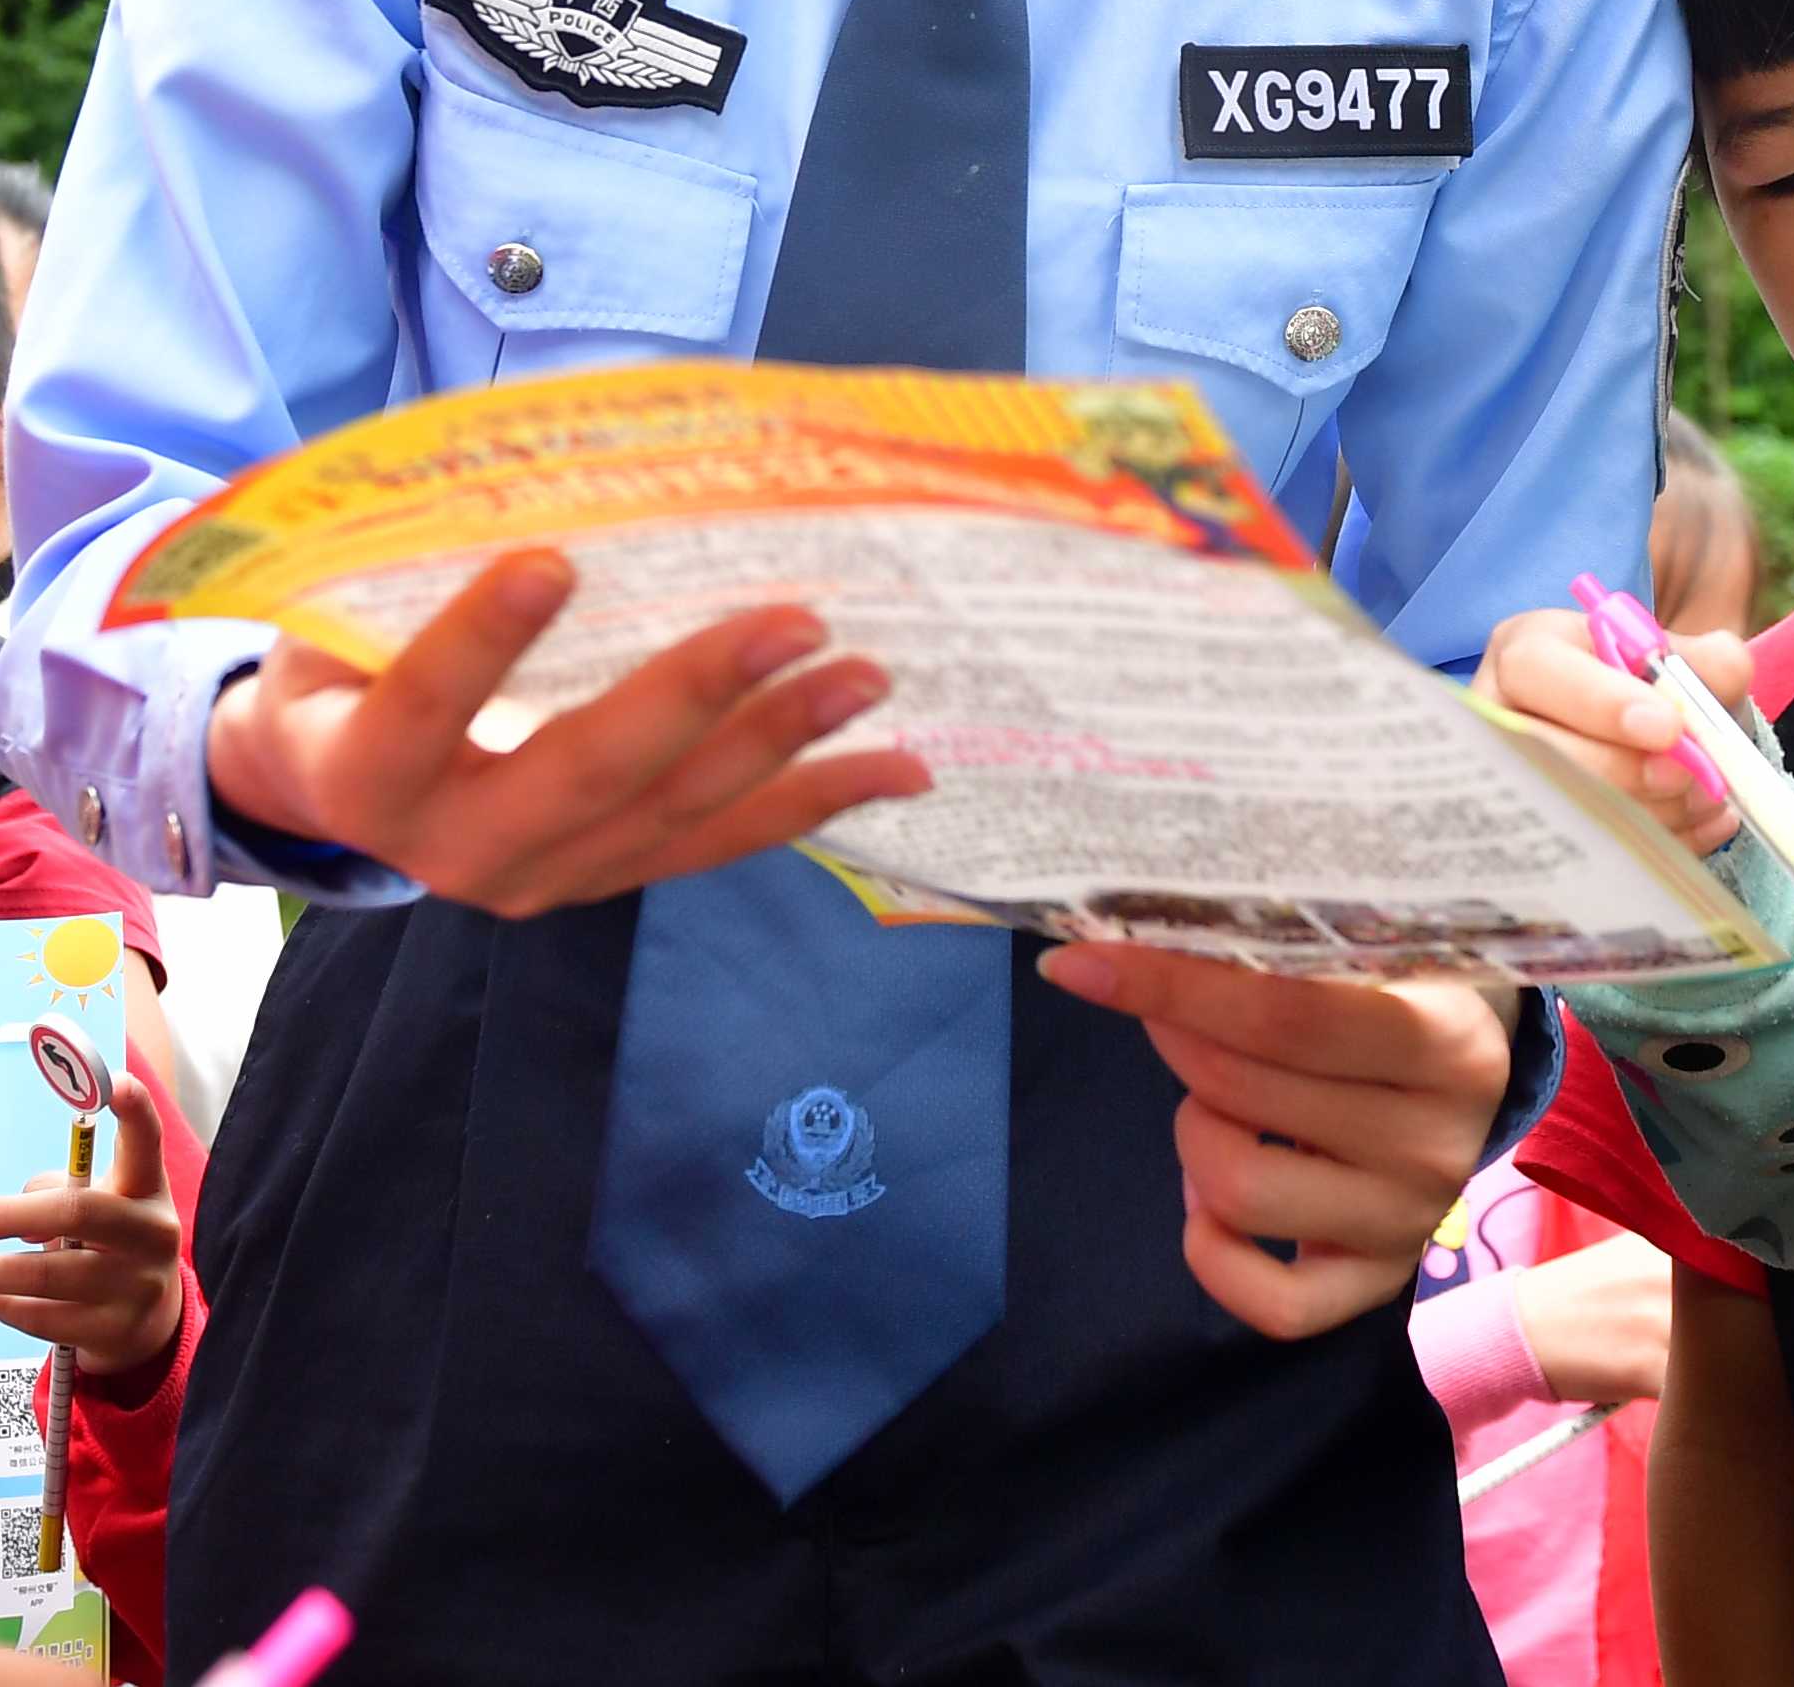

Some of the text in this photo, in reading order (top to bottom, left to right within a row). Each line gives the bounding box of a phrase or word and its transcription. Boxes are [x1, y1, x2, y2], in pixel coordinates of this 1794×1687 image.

[549, 11, 616, 44] POLICE
[1207, 68, 1450, 132] XG9477
[30, 1598, 44, 1607] APP
